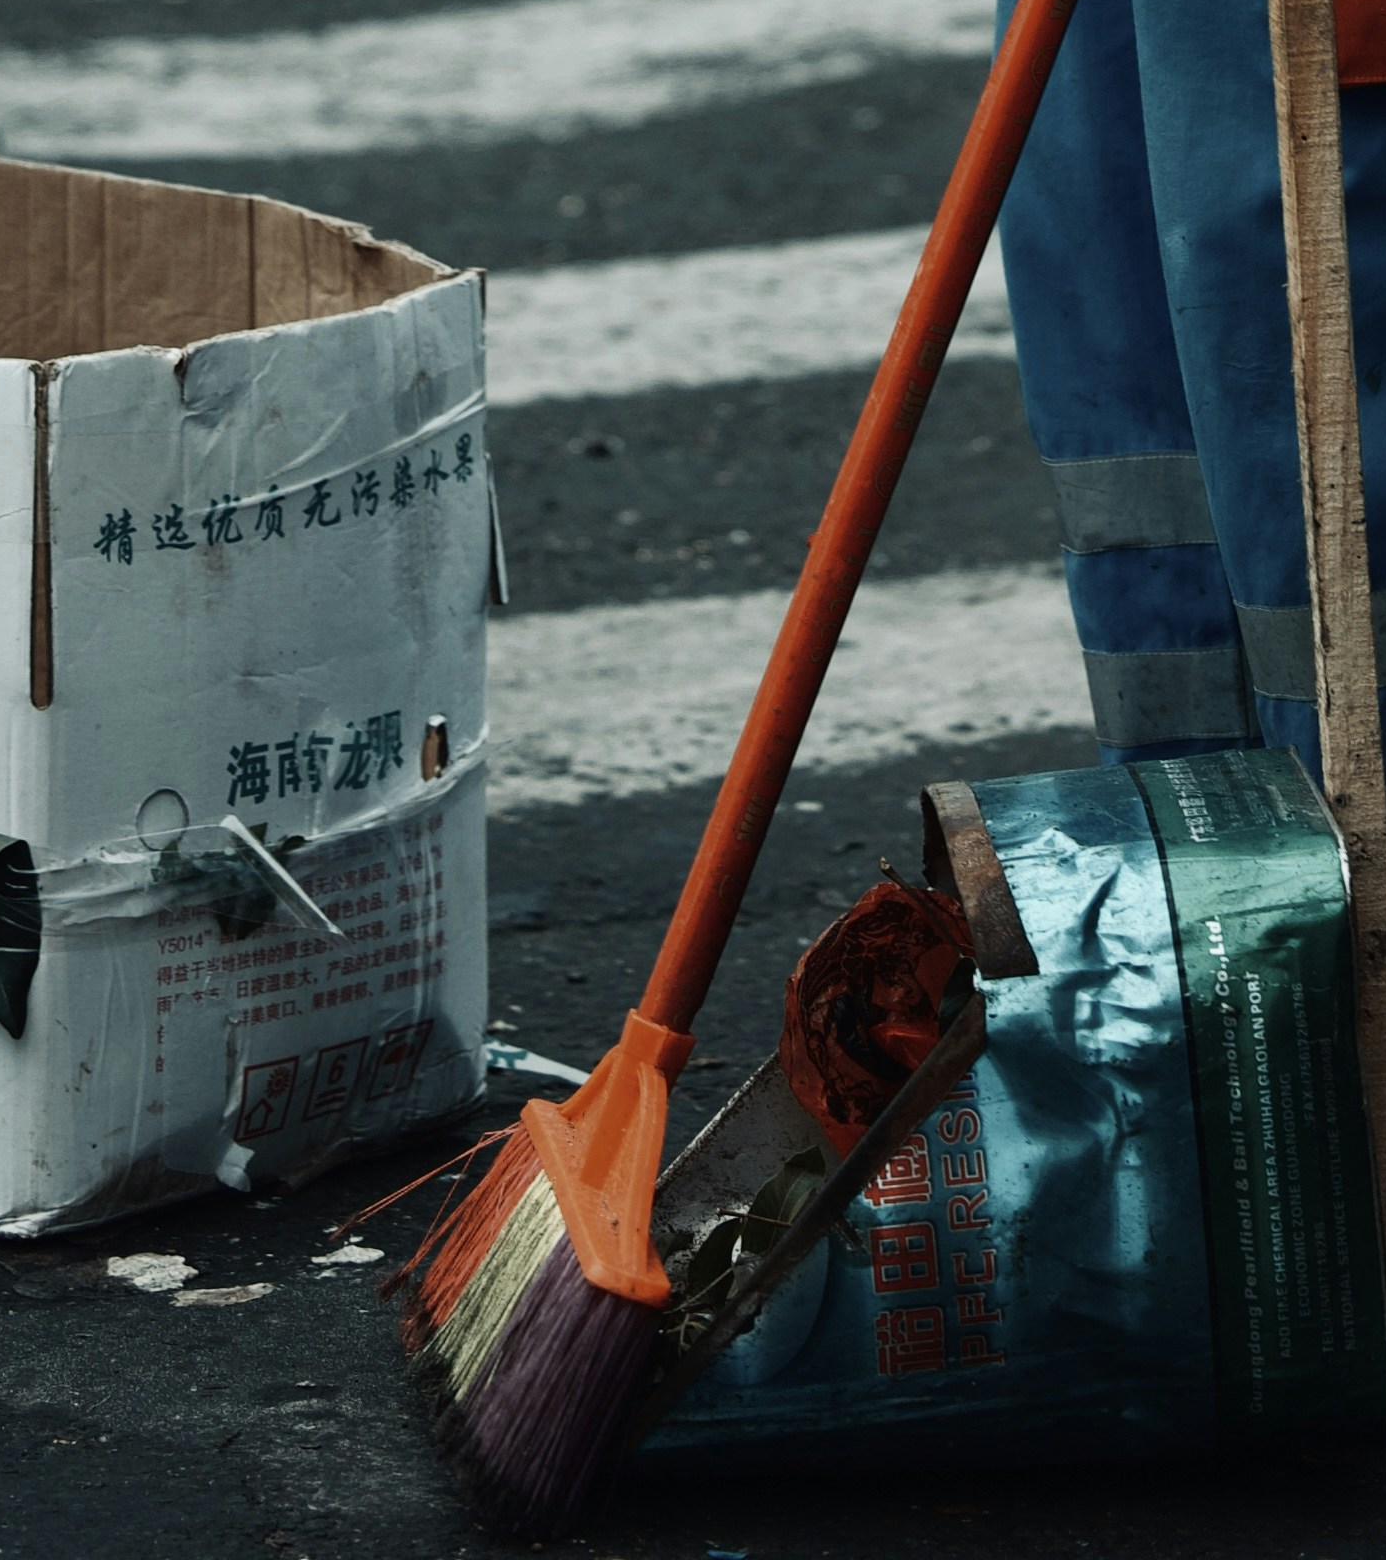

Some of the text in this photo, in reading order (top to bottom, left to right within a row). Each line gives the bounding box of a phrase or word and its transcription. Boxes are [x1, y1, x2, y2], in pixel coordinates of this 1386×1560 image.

[93, 432, 475, 566] 精选优质无污染水果
[226, 709, 404, 807] 海南龙眼
[1245, 971, 1264, 1014] PORT
[327, 1053, 349, 1086] 6
[1220, 1002, 1243, 1124] Technology
[1251, 1017, 1271, 1086] GAOLAN
[1230, 1131, 1248, 1171] Bali
[1235, 1178, 1249, 1191] &
[1326, 1130, 1345, 1196] HOTLINE
[937, 1071, 1006, 1367] PFC RESI
[1279, 1073, 1311, 1316] ECONOMIC ZONE GUANGDONG
[1332, 1201, 1350, 1265] SERVICE
[1236, 1198, 1258, 1300] Pearlfield
[1270, 1202, 1287, 1283] CHEMICAL
[1339, 1271, 1357, 1350] NATIONAL
[1247, 1306, 1264, 1414] Guangdong
